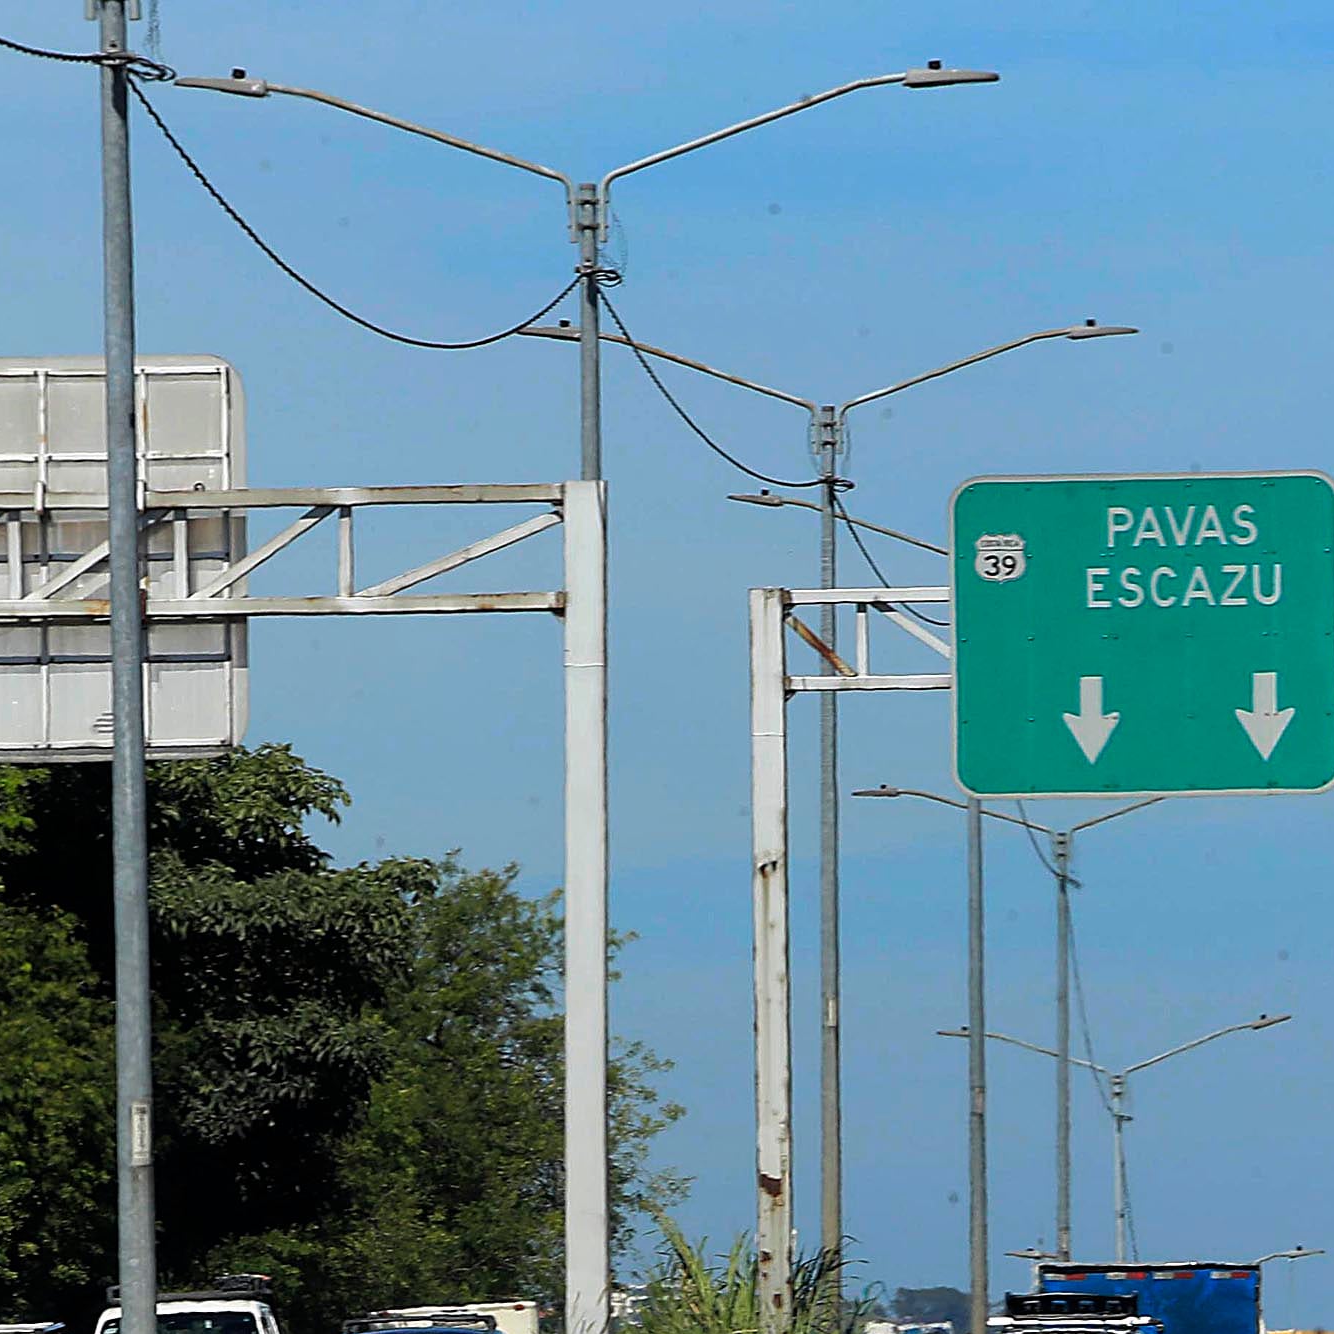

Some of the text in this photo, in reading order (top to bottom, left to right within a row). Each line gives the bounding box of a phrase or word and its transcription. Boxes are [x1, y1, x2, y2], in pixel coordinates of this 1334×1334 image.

[1107, 504, 1258, 547] PAVAS
[984, 555, 1017, 577] 39
[1086, 564, 1282, 608] ESCAZU
